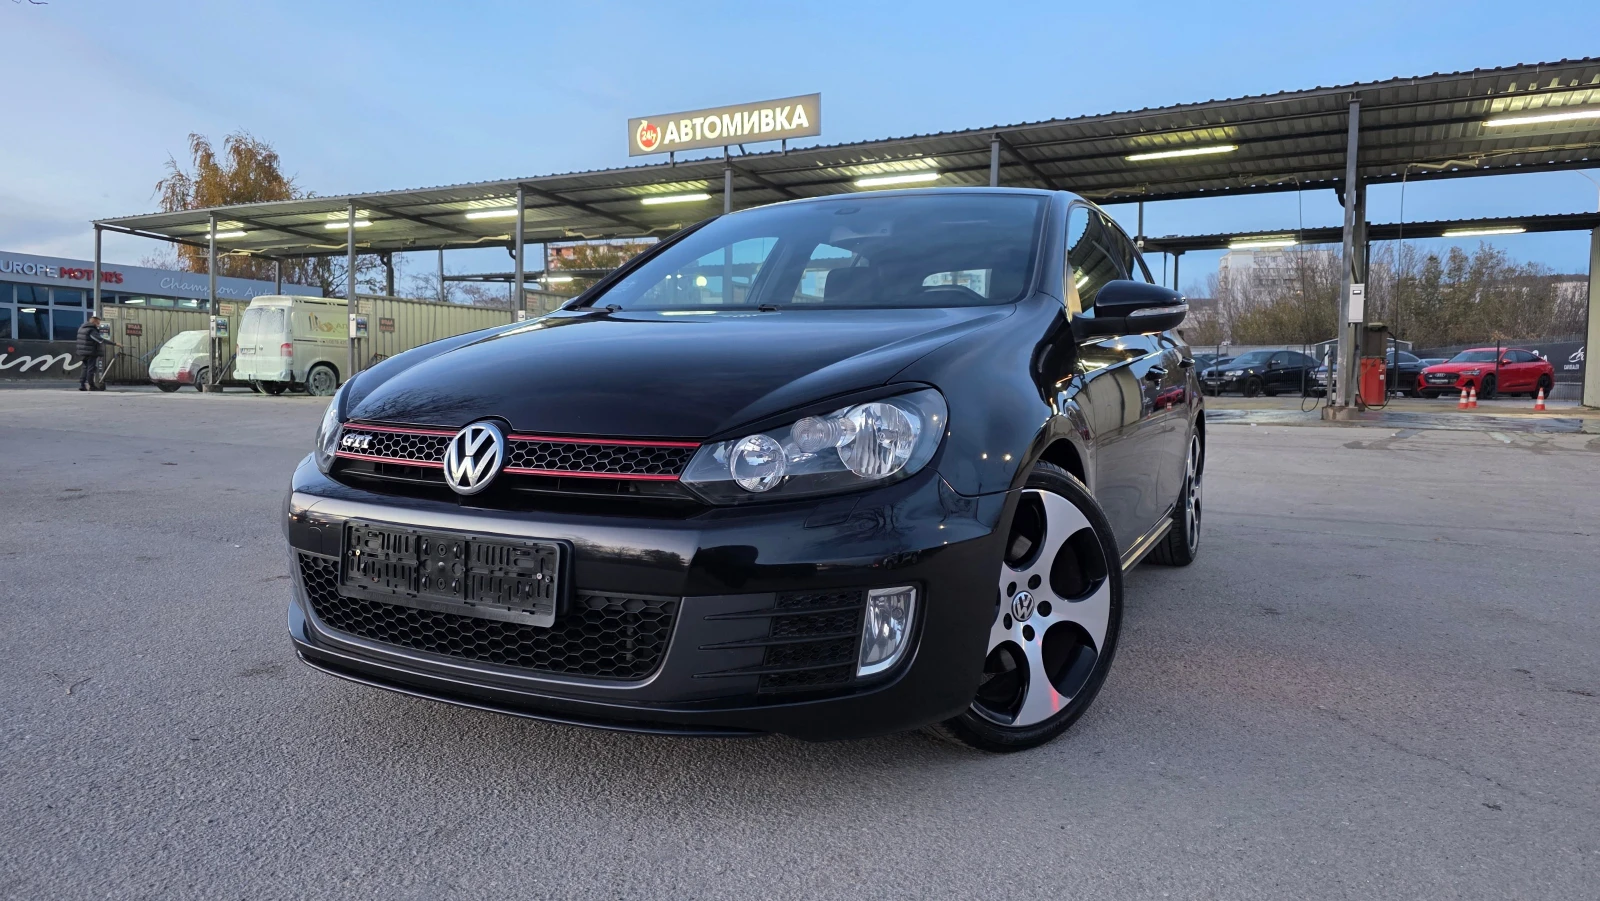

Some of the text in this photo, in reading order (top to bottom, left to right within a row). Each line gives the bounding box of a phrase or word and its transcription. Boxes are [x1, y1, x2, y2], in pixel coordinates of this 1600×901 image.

[663, 104, 810, 144] АВТОМИВКА
[0, 260, 58, 278] UROPE
[160, 277, 238, 297] Champon
[342, 433, 373, 449] GTI
